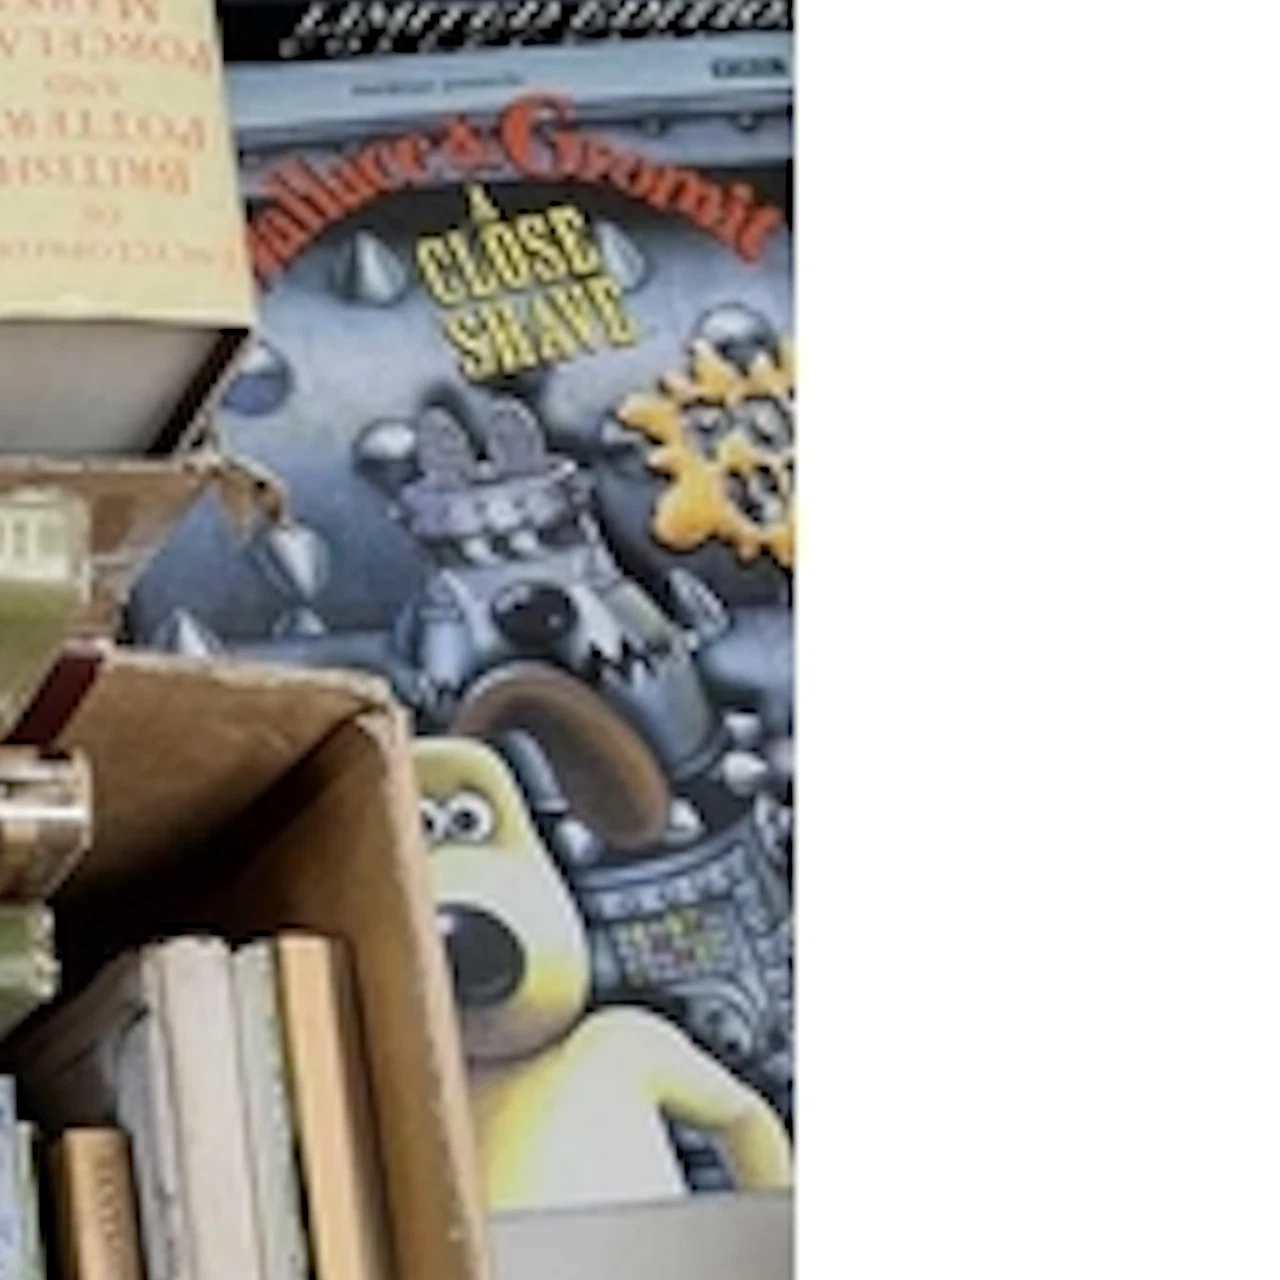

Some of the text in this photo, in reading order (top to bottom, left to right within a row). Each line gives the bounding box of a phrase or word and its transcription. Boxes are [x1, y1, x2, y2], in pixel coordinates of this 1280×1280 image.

[44, 73, 125, 97] AND
[240, 93, 783, 292] allace & Gromit
[465, 180, 501, 224] A
[417, 203, 601, 307] CLOSE
[445, 277, 640, 383] SHAVE
